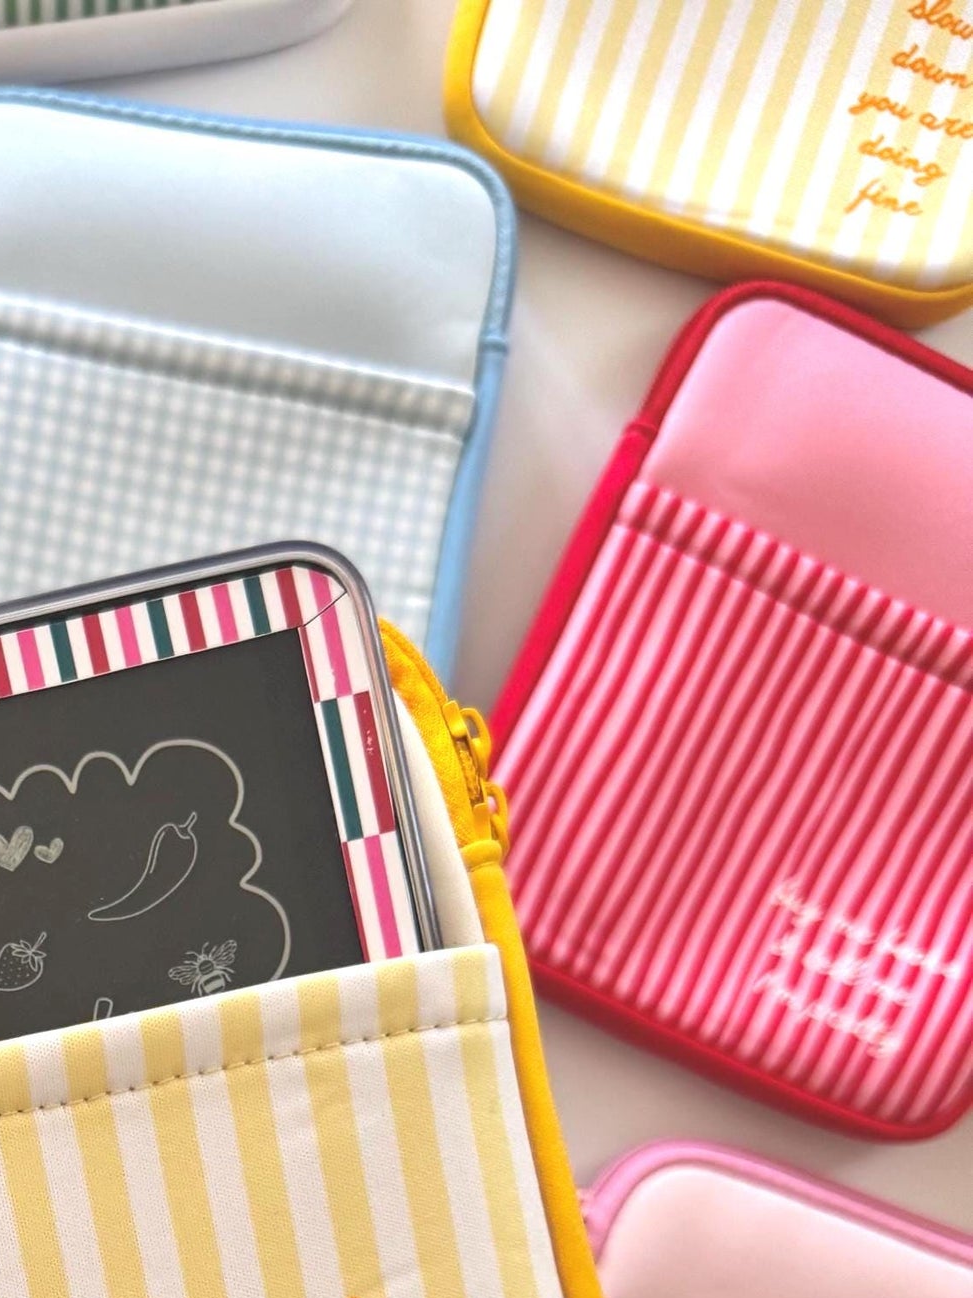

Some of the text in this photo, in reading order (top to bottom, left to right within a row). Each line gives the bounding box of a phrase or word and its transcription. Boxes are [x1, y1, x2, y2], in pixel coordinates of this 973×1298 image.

[891, 43, 973, 89] down
[847, 91, 914, 121] you
[857, 134, 948, 188] doing
[843, 178, 924, 217] fine
